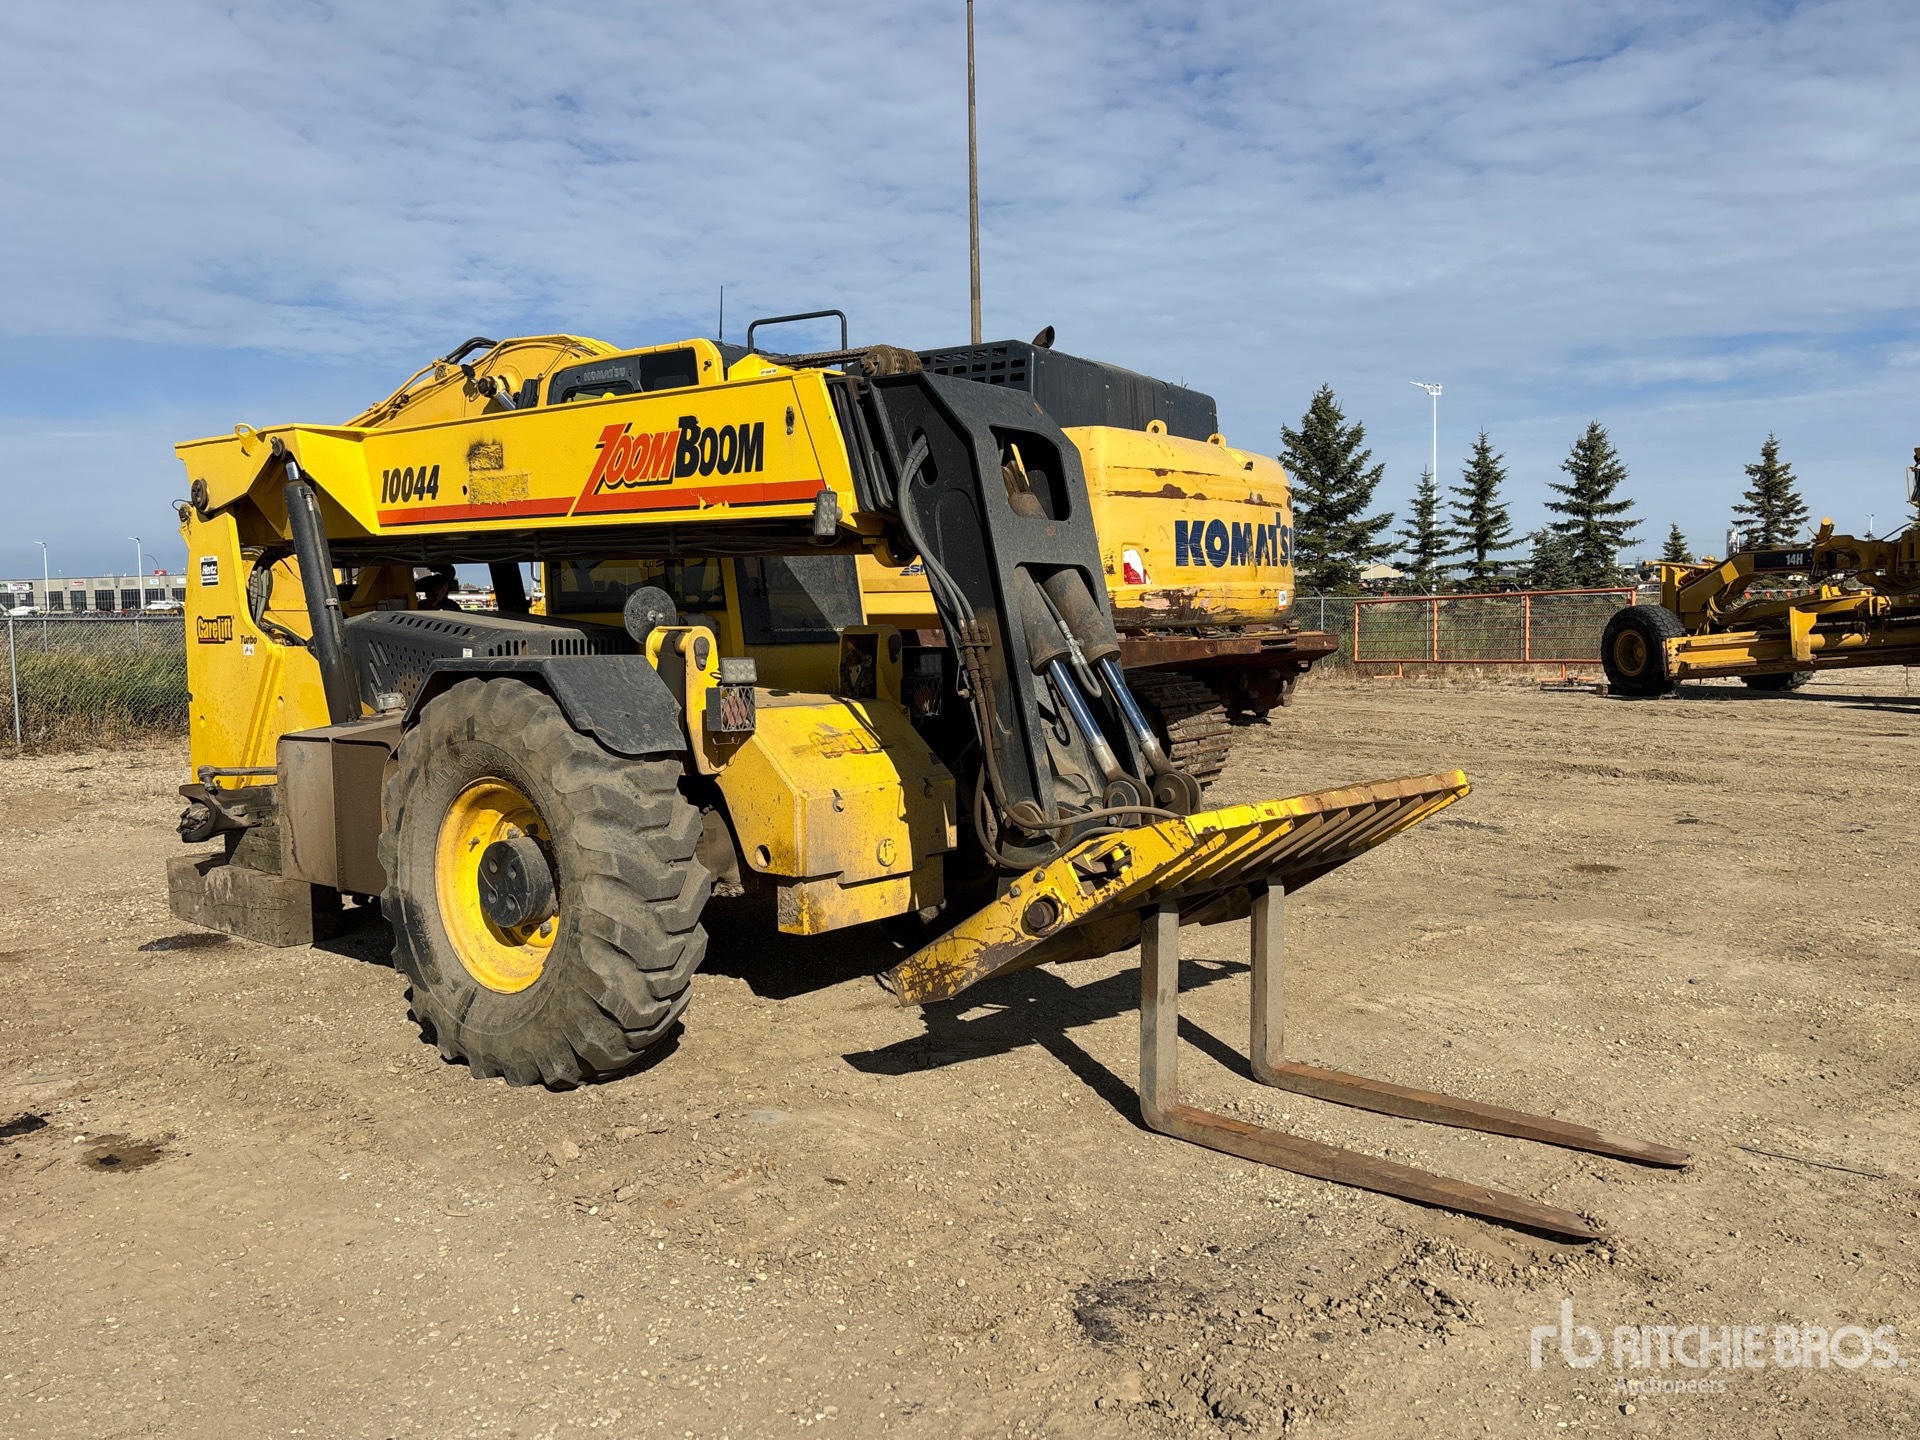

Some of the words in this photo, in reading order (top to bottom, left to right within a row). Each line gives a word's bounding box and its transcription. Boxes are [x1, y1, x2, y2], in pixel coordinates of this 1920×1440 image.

[583, 365, 626, 382] KOMATSU
[381, 464, 440, 504] 10044
[1785, 553, 1803, 565] 14H
[202, 564, 217, 575] Hertz
[240, 635, 257, 644] Turbo
